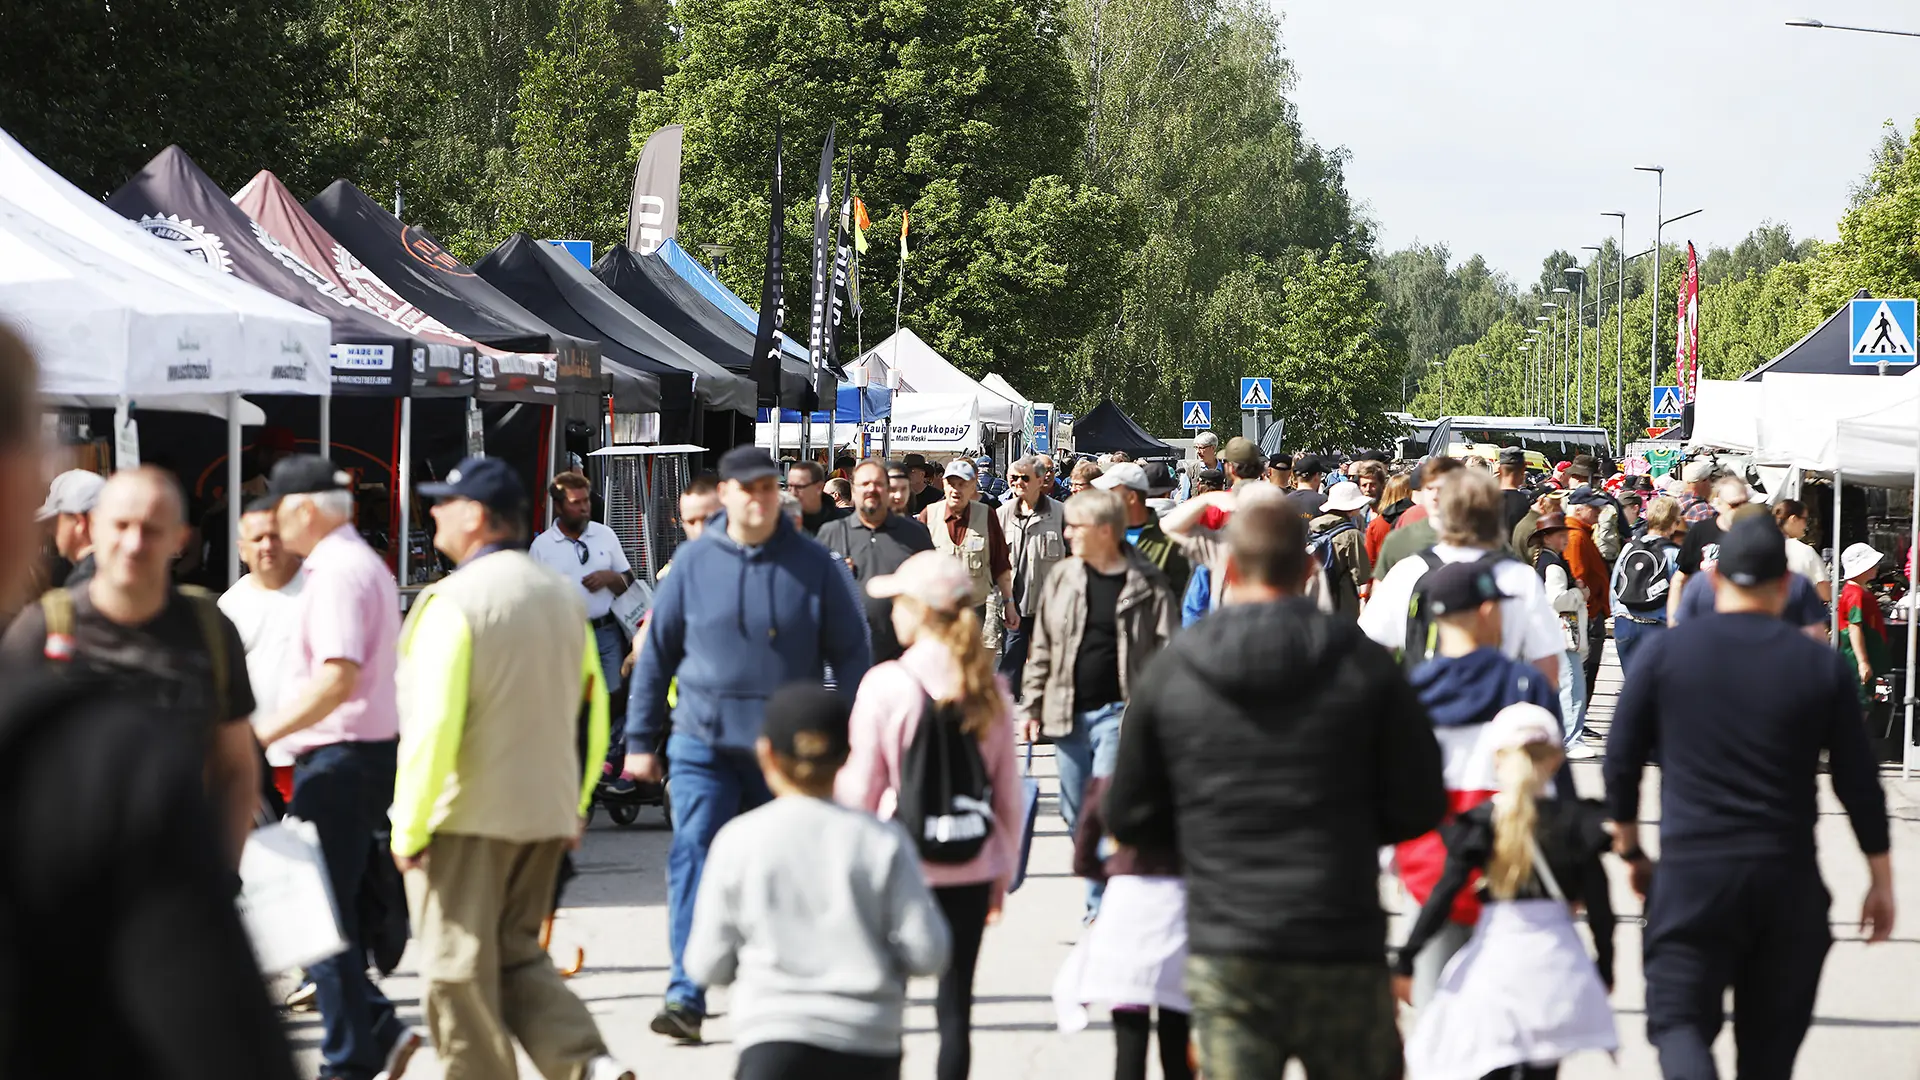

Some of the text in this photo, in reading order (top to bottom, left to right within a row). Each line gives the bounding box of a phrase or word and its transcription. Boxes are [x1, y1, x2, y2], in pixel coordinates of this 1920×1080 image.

[347, 348, 383, 356] MADE IN
[346, 358, 383, 366] FINLAND
[863, 424, 964, 436] Kauhvan Puukkopaja
[895, 434, 927, 442] Matti Koski
